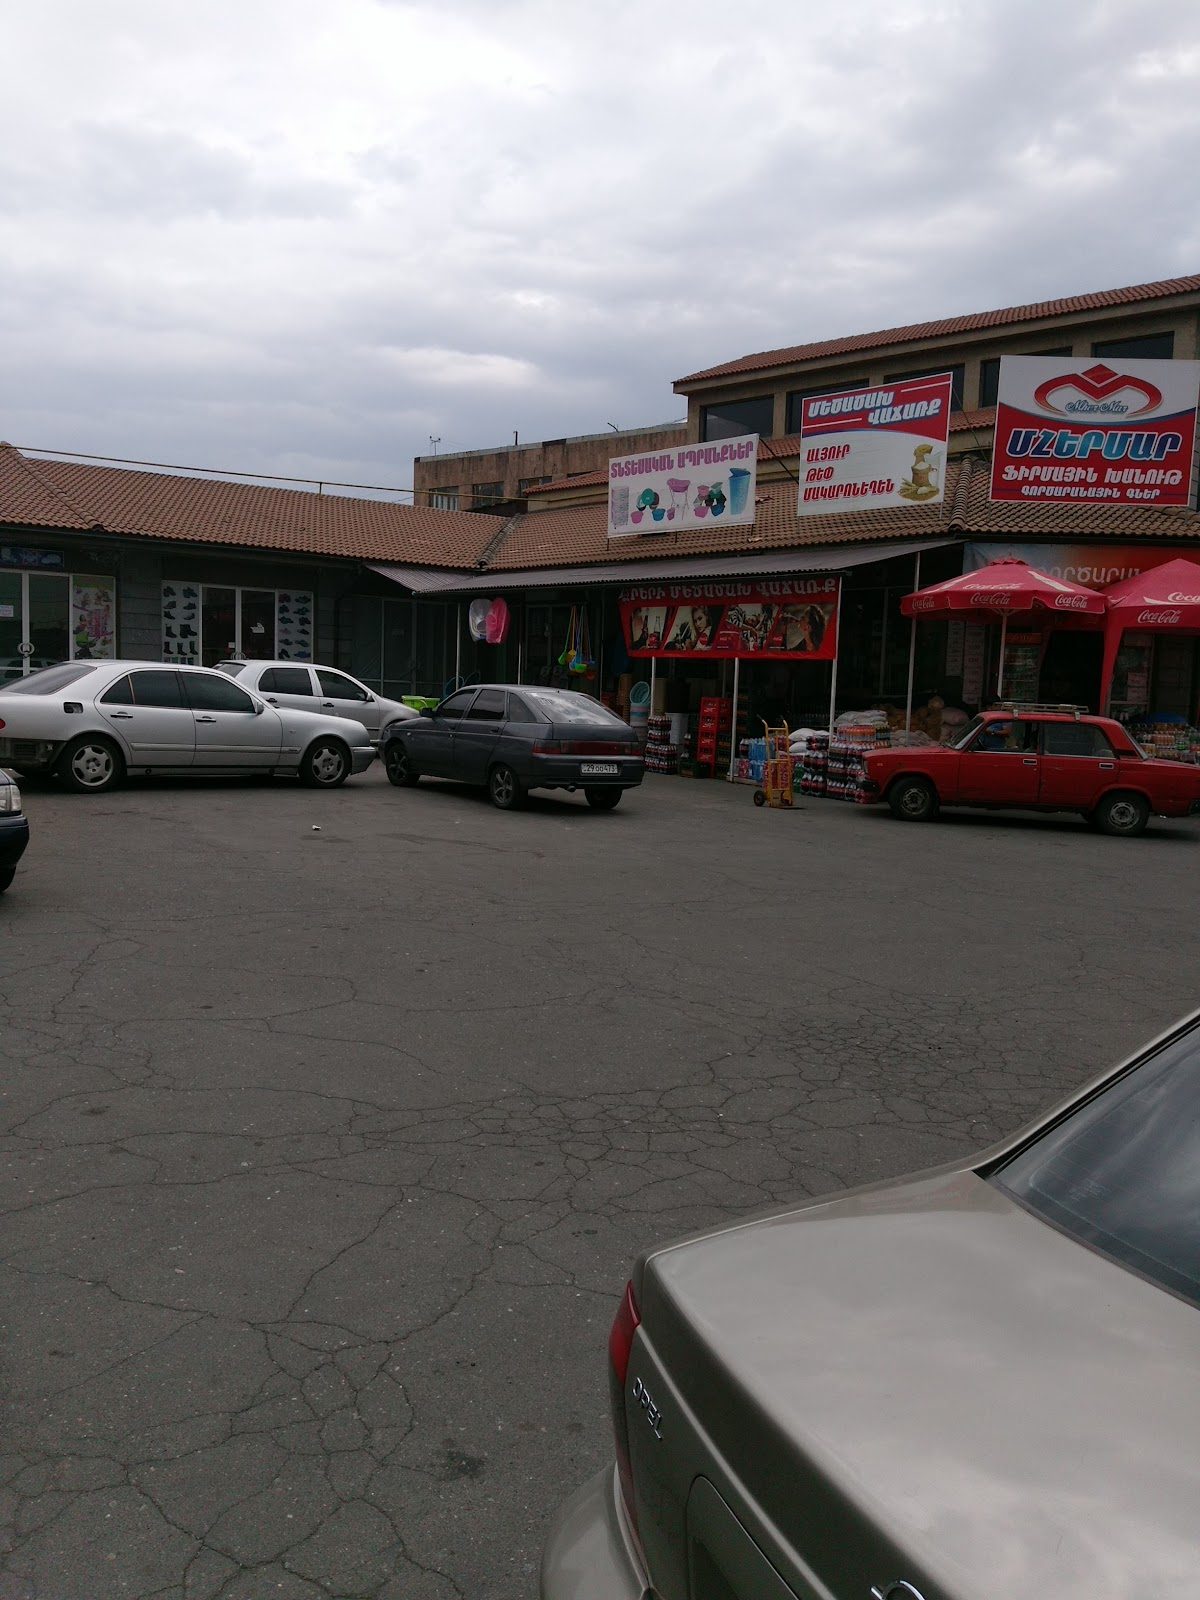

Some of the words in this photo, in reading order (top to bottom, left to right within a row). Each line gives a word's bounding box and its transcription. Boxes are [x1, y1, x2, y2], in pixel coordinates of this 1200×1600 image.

[808, 391, 895, 418] ՄԵԾԱԾԱԽ
[867, 398, 942, 425] ՎԱՃԱՌՔ
[806, 443, 851, 463] ԱԼՅՈՒՐ
[1006, 428, 1182, 461] ՄՀԵՐՄԱՐ
[610, 454, 675, 479] ՏՆՏԵՍԱԿԱՆ
[677, 440, 754, 469] ԱՊՐԱՆՔՆԵՐ
[805, 466, 834, 482] ԹԵՓ
[1002, 465, 1098, 483] ՖԻՐՄԱՅԻՆ
[1104, 468, 1183, 485] ԽԱՆՈՒԹ
[803, 478, 895, 502] ՄԱԿԱՐՈՆԵՂԵՆ
[1021, 485, 1121, 498] ԳՈՐԾԱՐԱՆԱՅԻՆ
[1126, 489, 1161, 500] ԳՆԵՐ
[1137, 609, 1183, 624] Coca-Cola
[632, 1376, 662, 1439] OPEL
